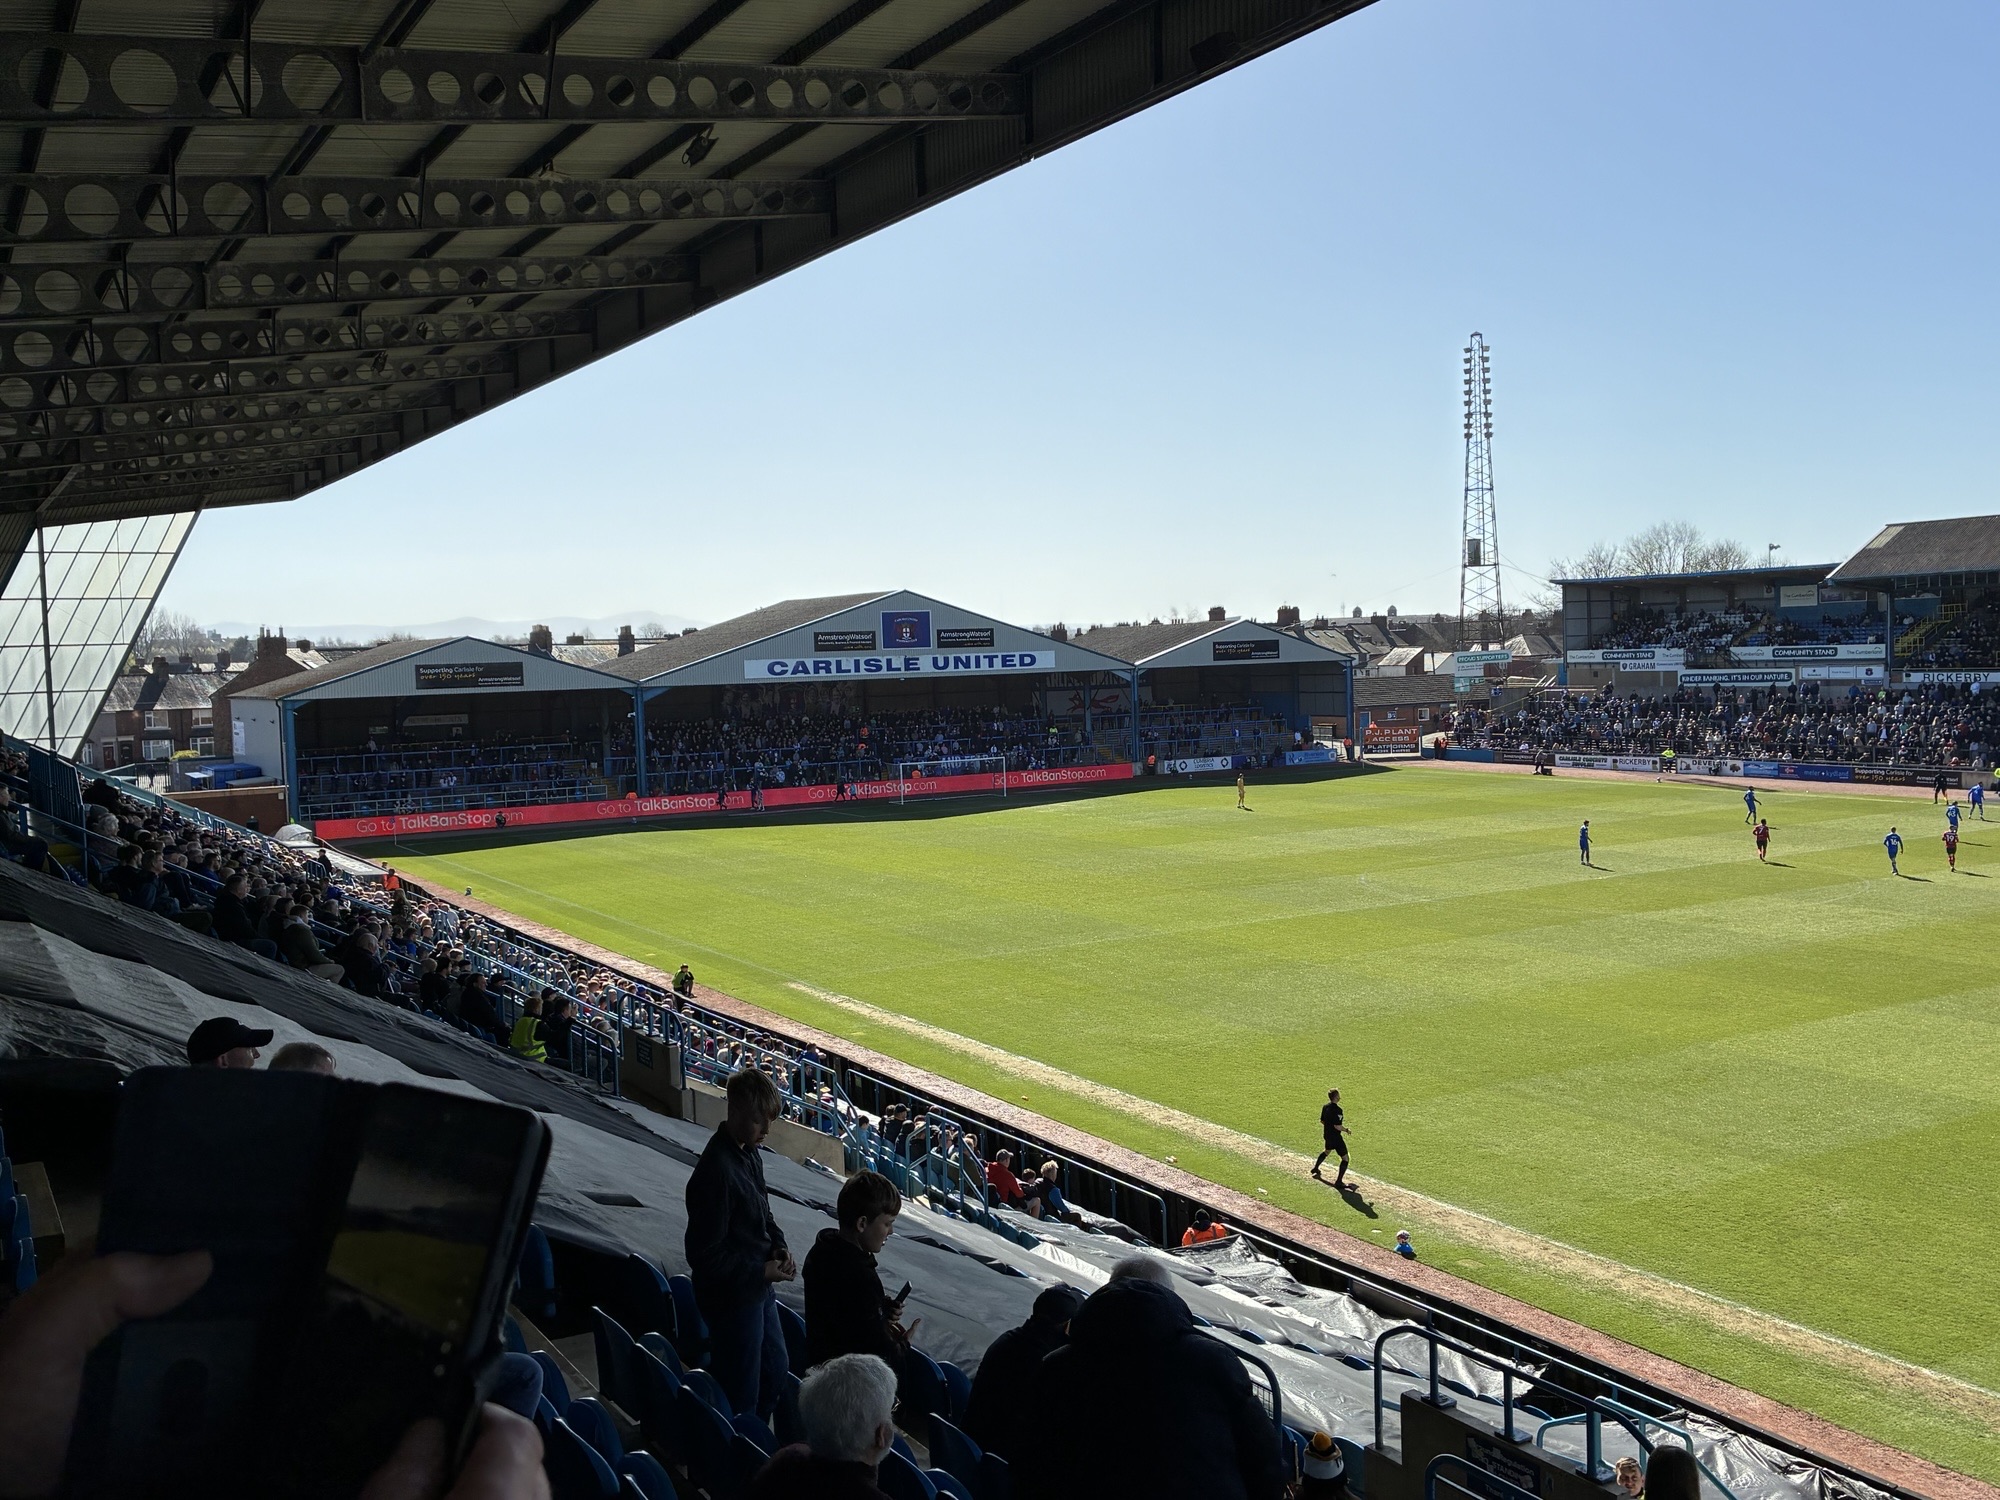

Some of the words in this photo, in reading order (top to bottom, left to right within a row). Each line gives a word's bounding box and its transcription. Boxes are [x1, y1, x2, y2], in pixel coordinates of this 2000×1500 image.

[817, 633, 873, 642] ArmstrongWatson
[940, 631, 991, 639] ArmstrongWatson
[1774, 649, 1814, 657] COMMUNITY
[1814, 648, 1836, 656] STAND
[767, 656, 920, 676] CARLISLE
[932, 653, 1037, 670] UNITED
[1628, 662, 1656, 670] GRAHAM
[1924, 673, 1990, 682] RICKERBY
[1384, 728, 1417, 736] PLANT
[1618, 758, 1651, 766] RICKERBY
[1009, 774, 1019, 784] to
[1021, 768, 1107, 784] TalkBanStop.com
[1854, 767, 1885, 776] Supporting
[1871, 774, 1884, 782] 150
[1885, 775, 1906, 783] years
[808, 787, 824, 799] Go
[597, 802, 615, 815] Go
[618, 802, 632, 813] to
[634, 795, 744, 812] TalkBanStopom
[357, 819, 377, 833] Go
[381, 818, 395, 831] to
[1890, 838, 1898, 846] 16
[1945, 834, 1955, 842] 19
